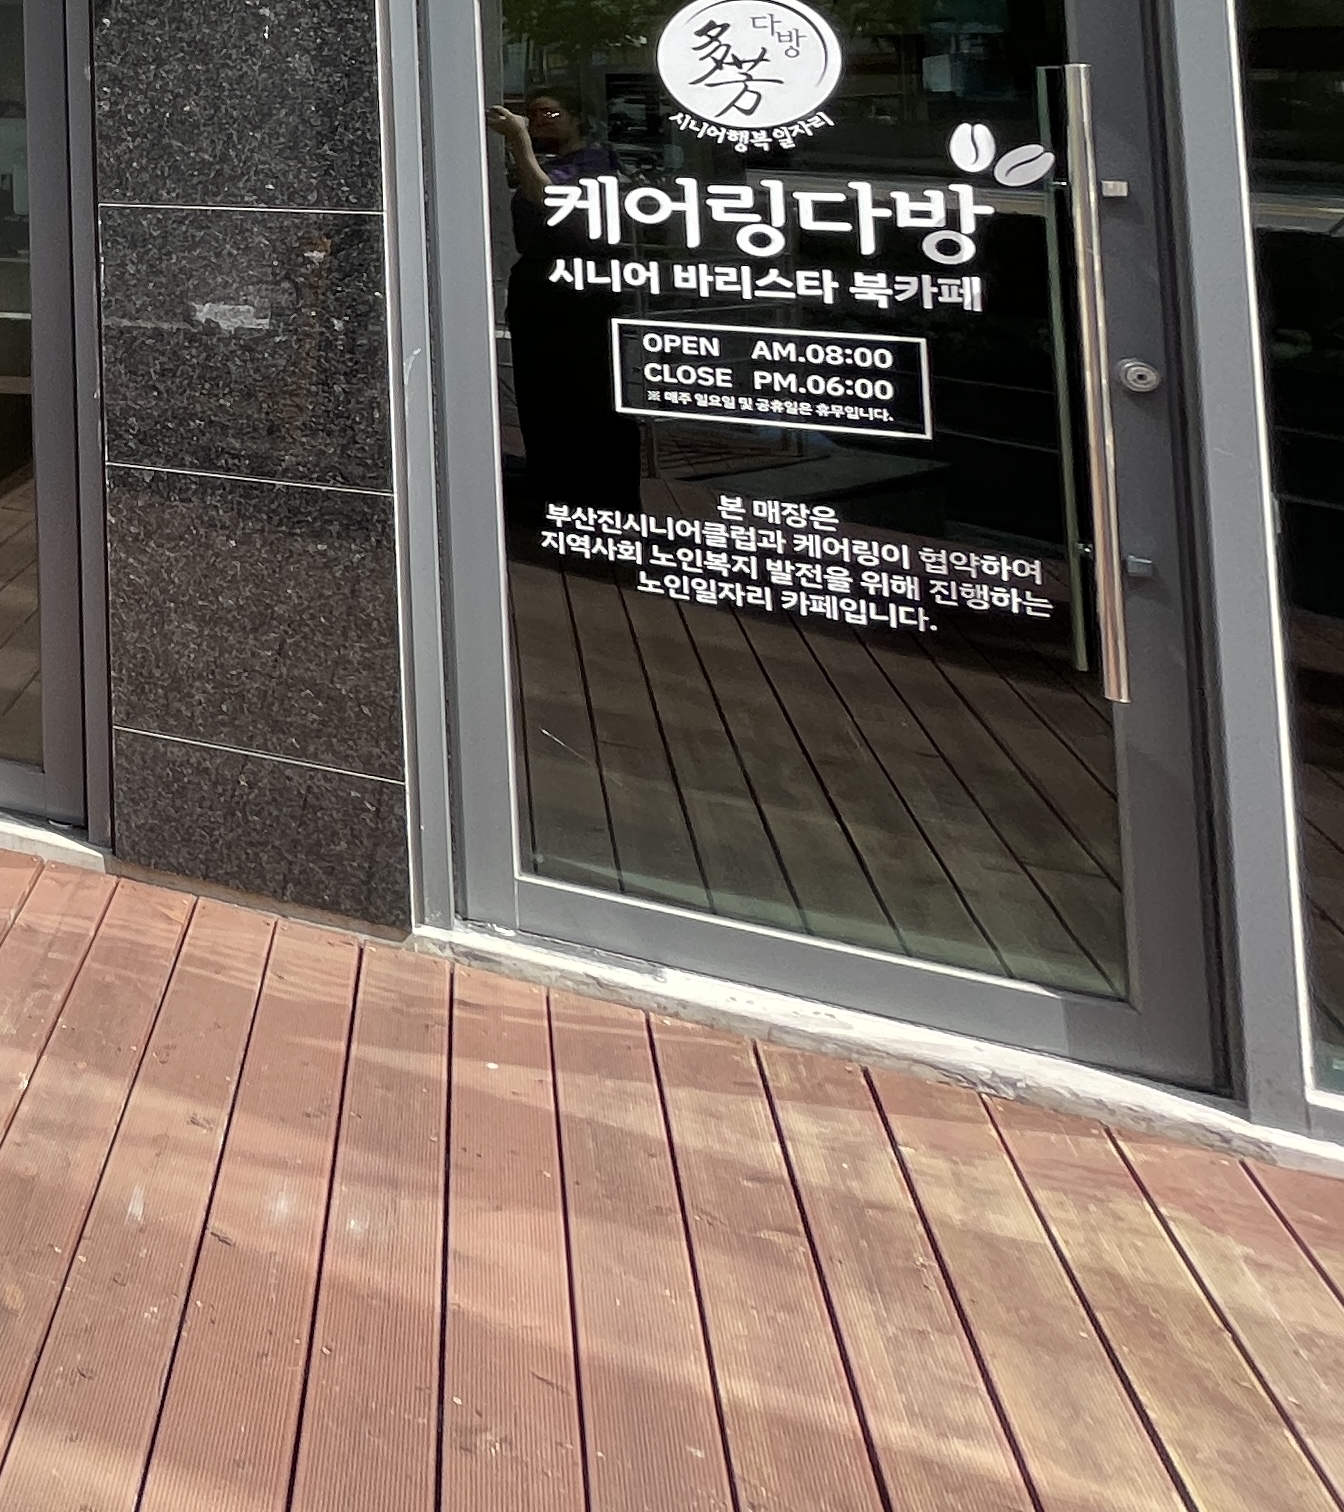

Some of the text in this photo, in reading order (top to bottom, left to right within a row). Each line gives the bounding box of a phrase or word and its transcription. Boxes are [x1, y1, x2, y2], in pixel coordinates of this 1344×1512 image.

[750, 13, 808, 58] 다방
[543, 175, 995, 265] 케어링다방
[548, 257, 983, 312] 시니어 바리스타 북카페
[642, 333, 893, 369] OPEN AM.08:00
[643, 362, 894, 400] CLOSE PM.06:00
[664, 391, 692, 405] 매주
[694, 392, 736, 410] 일요일
[738, 396, 754, 411] 및
[754, 398, 814, 416] 공휴일은
[716, 495, 840, 532] 본 매장은
[545, 503, 1044, 585] 부산진시니어클럽과 케어링이 협약하여
[541, 530, 1054, 618] 지역사회 노인복지 발전을 위해 진행하는
[636, 570, 938, 632] 노인일자리 카페입니다.
